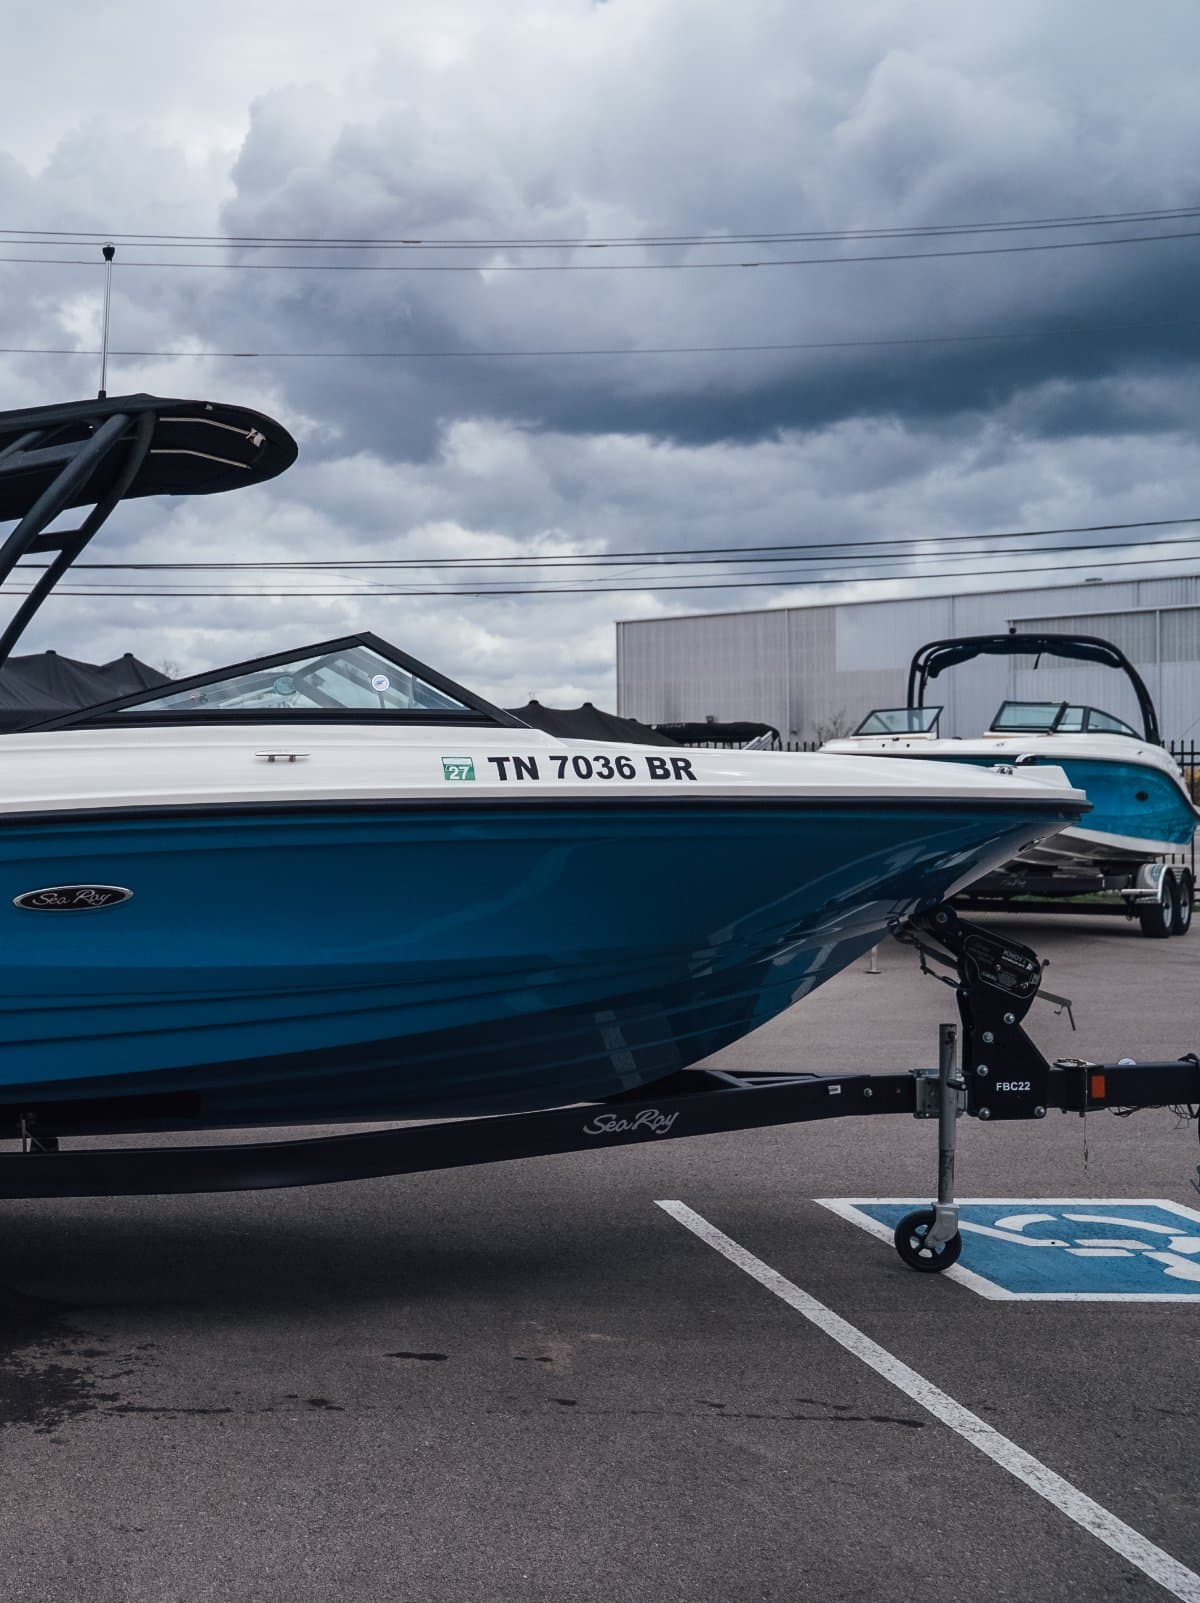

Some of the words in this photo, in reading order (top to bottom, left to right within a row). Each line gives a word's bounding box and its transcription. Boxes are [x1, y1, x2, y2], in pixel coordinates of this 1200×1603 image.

[449, 766, 470, 780] 27
[487, 756, 540, 781] TN
[549, 755, 636, 780] 7036
[645, 756, 698, 781] BR
[32, 893, 68, 905] Sea
[72, 889, 112, 905] Ray
[996, 1081, 1031, 1092] FBC22
[583, 1114, 632, 1134] Sea
[631, 1109, 680, 1134] Ray
